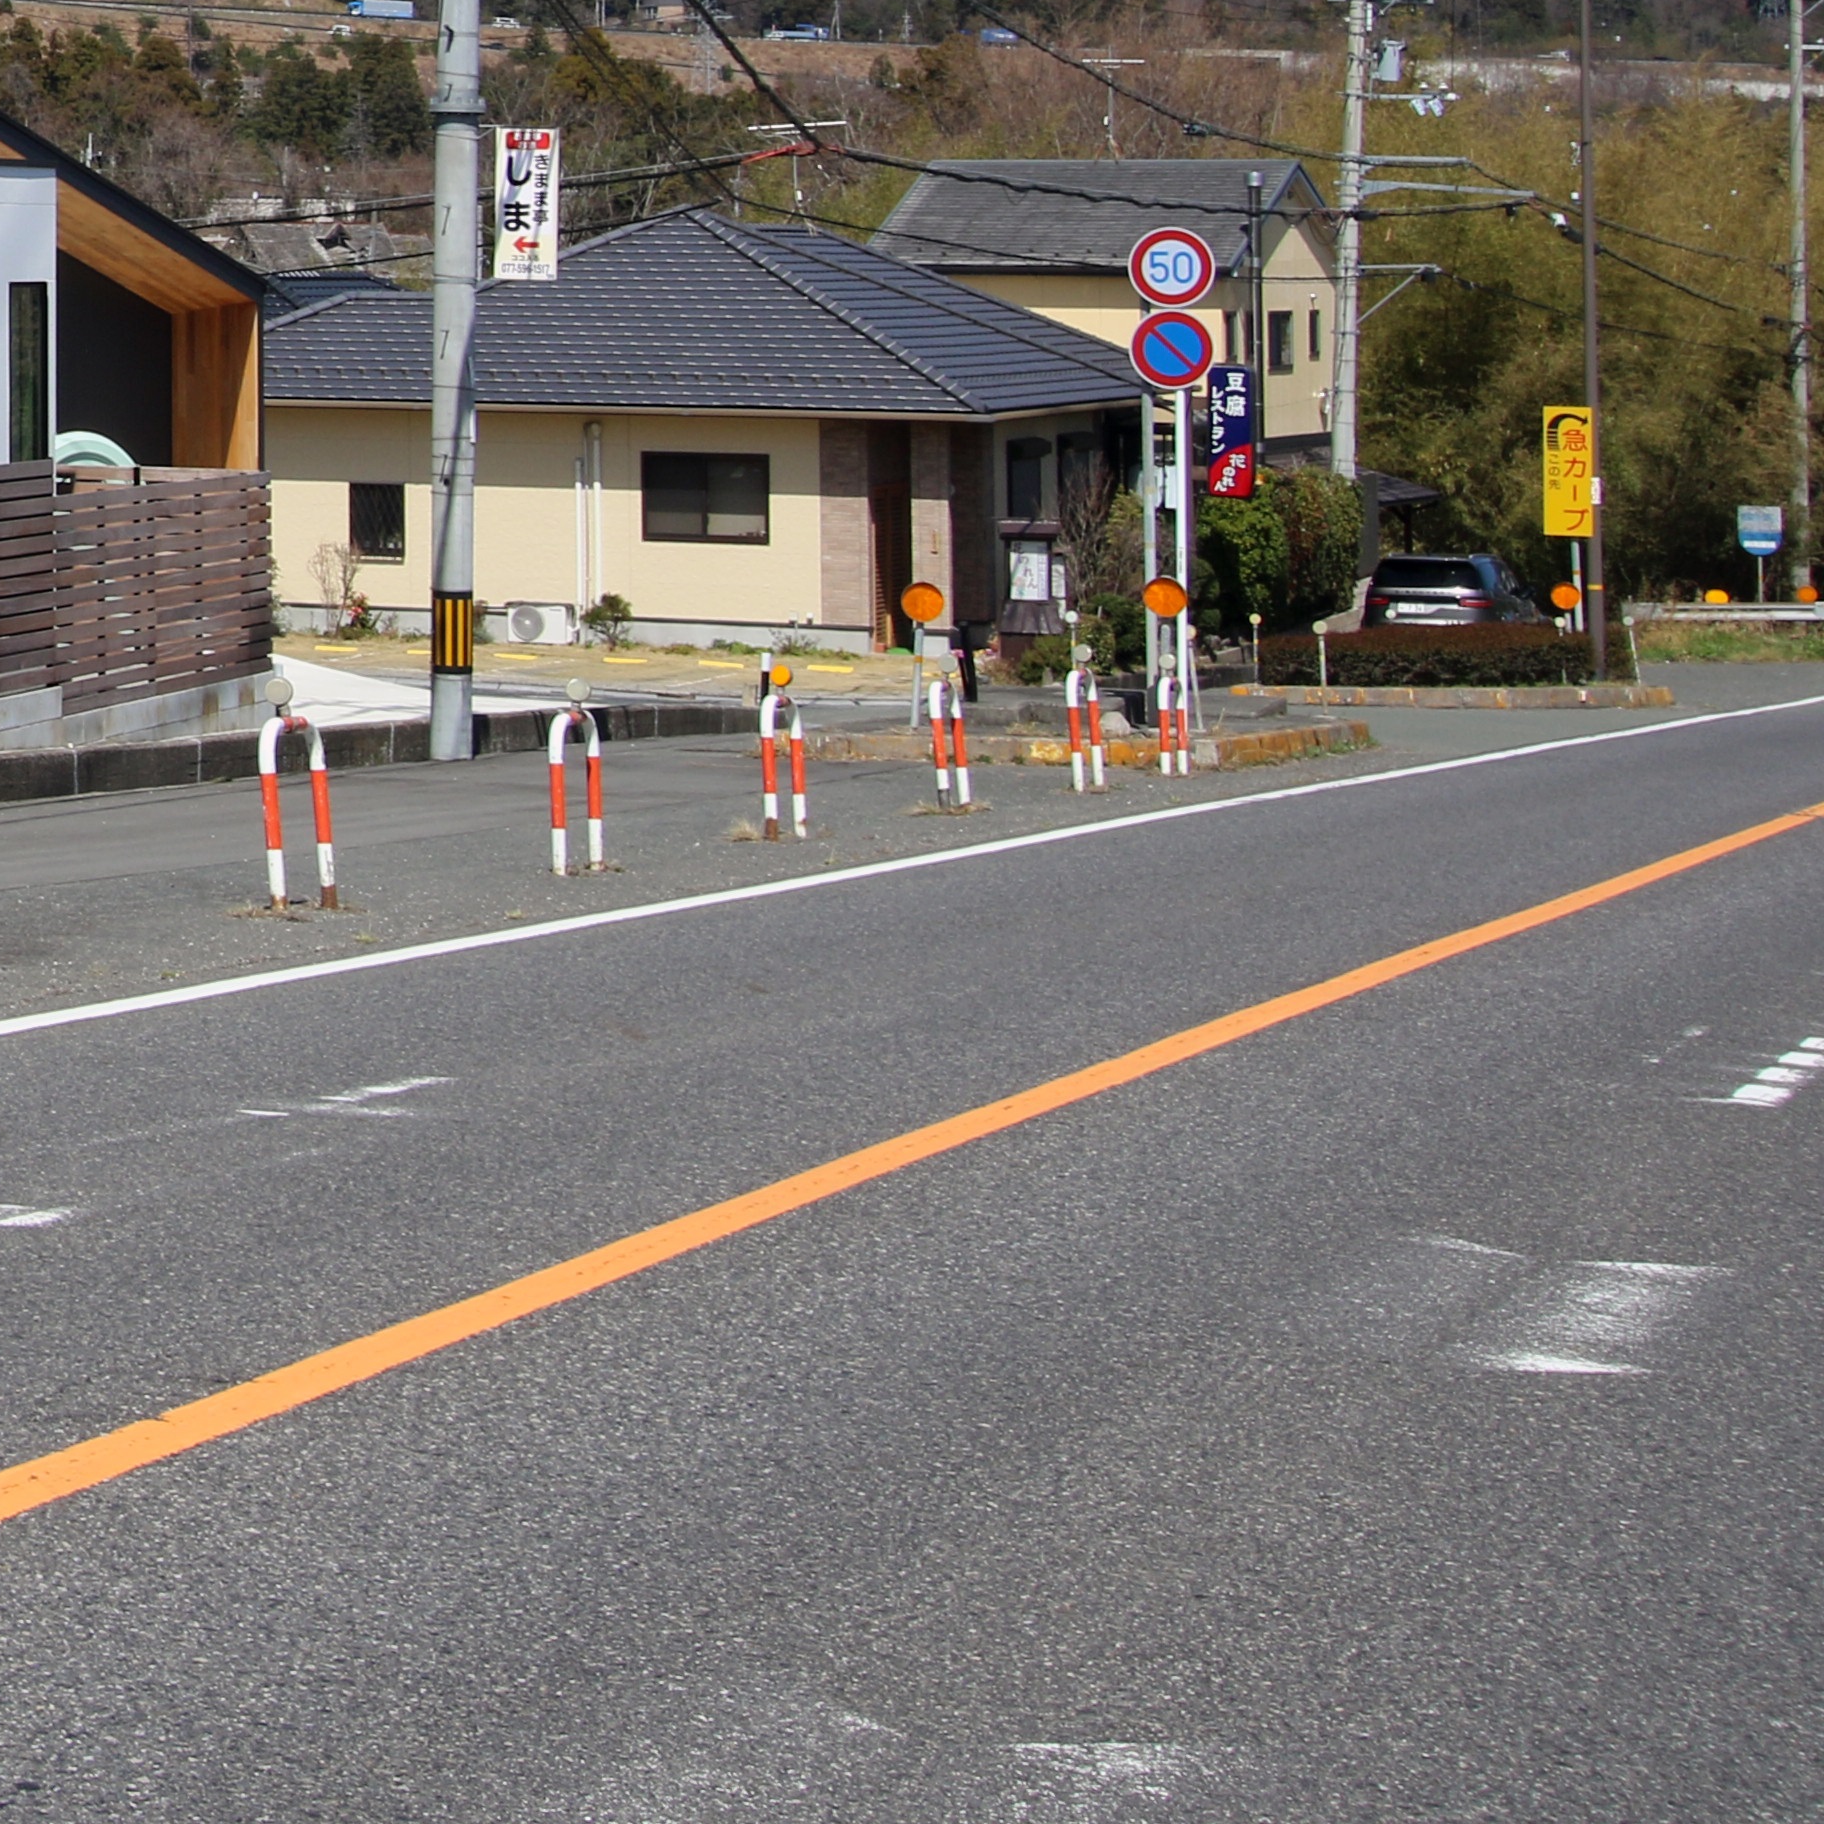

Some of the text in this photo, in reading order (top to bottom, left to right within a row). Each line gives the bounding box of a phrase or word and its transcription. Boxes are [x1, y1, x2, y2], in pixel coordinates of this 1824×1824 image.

[503, 156, 532, 232] しま
[1149, 251, 1194, 284] 50
[1225, 372, 1246, 416] 豆腐
[1211, 386, 1225, 454] レストラン
[1214, 454, 1246, 492] 花のれん
[1548, 453, 1561, 490] この先
[1562, 429, 1590, 531] 急カーブ
